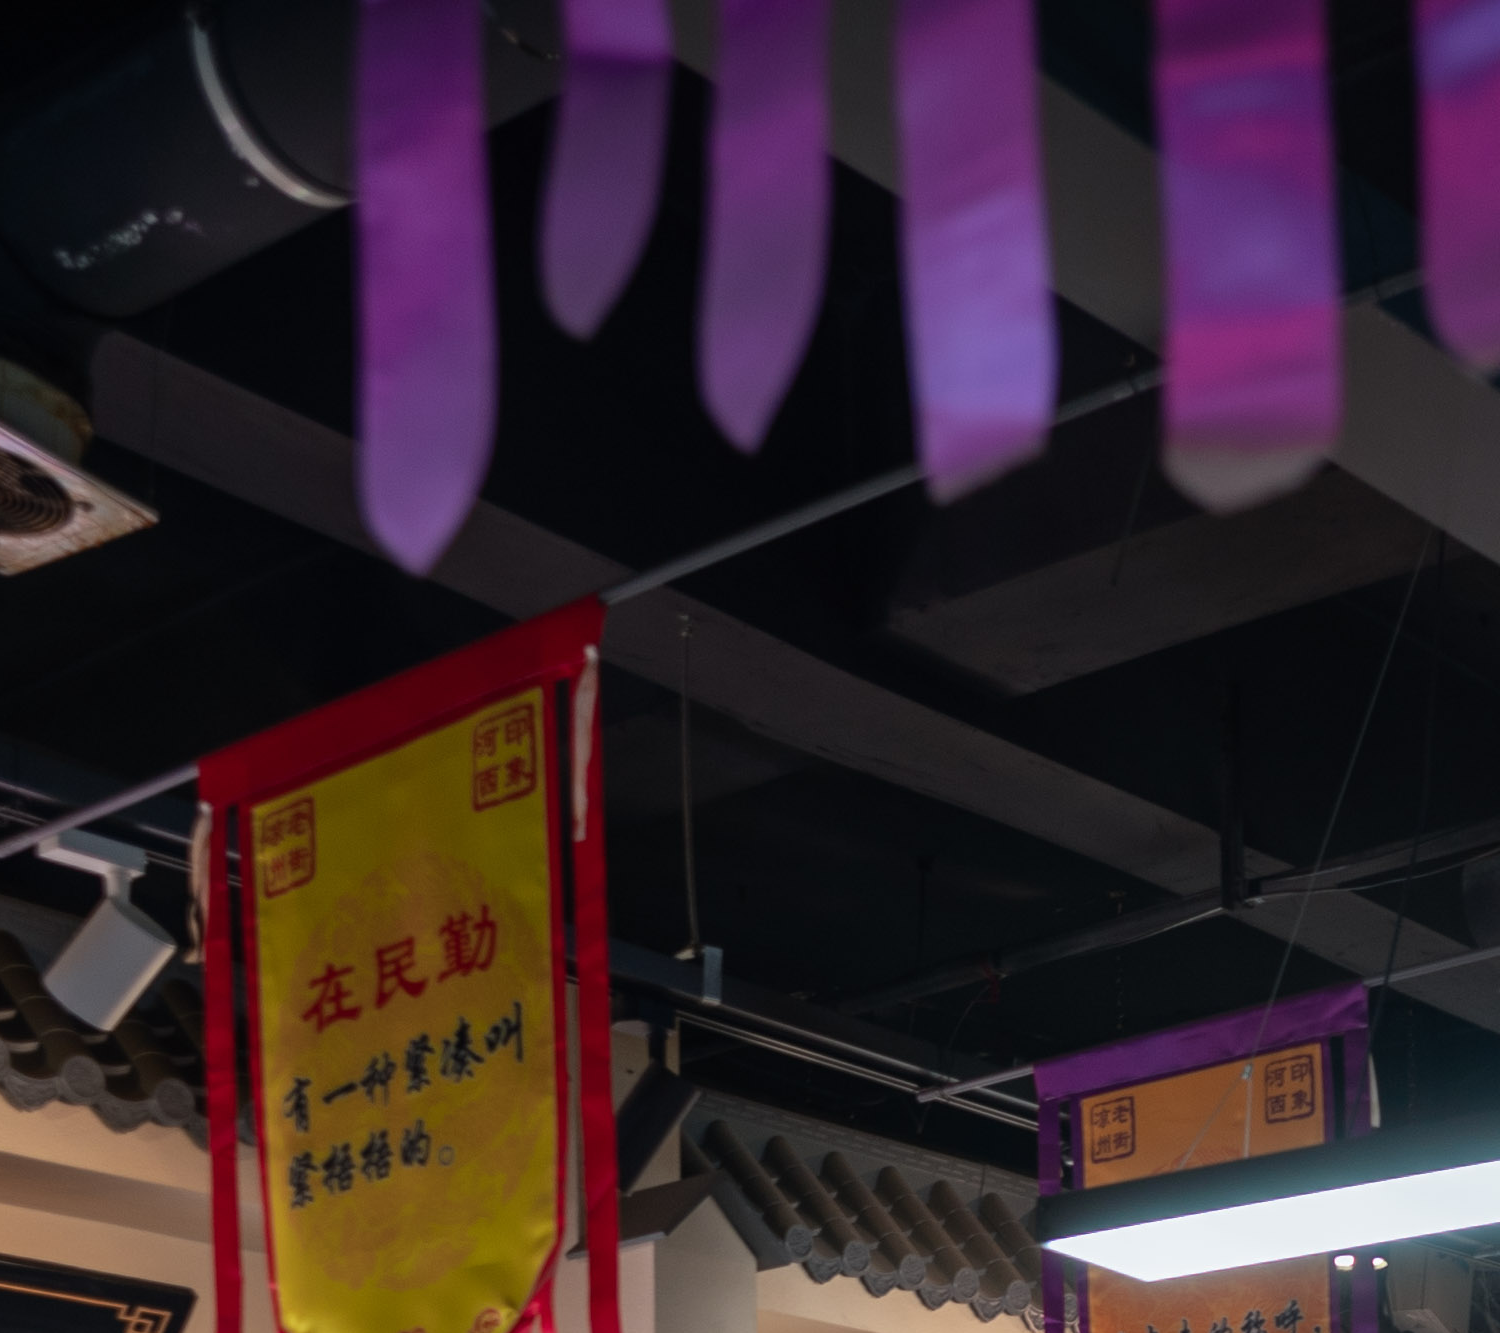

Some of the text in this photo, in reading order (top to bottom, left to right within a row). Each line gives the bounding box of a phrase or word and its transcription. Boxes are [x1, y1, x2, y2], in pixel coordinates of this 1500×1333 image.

[302, 902, 500, 1034] 在民勤
[284, 1000, 527, 1130] 有一种紧凑叫
